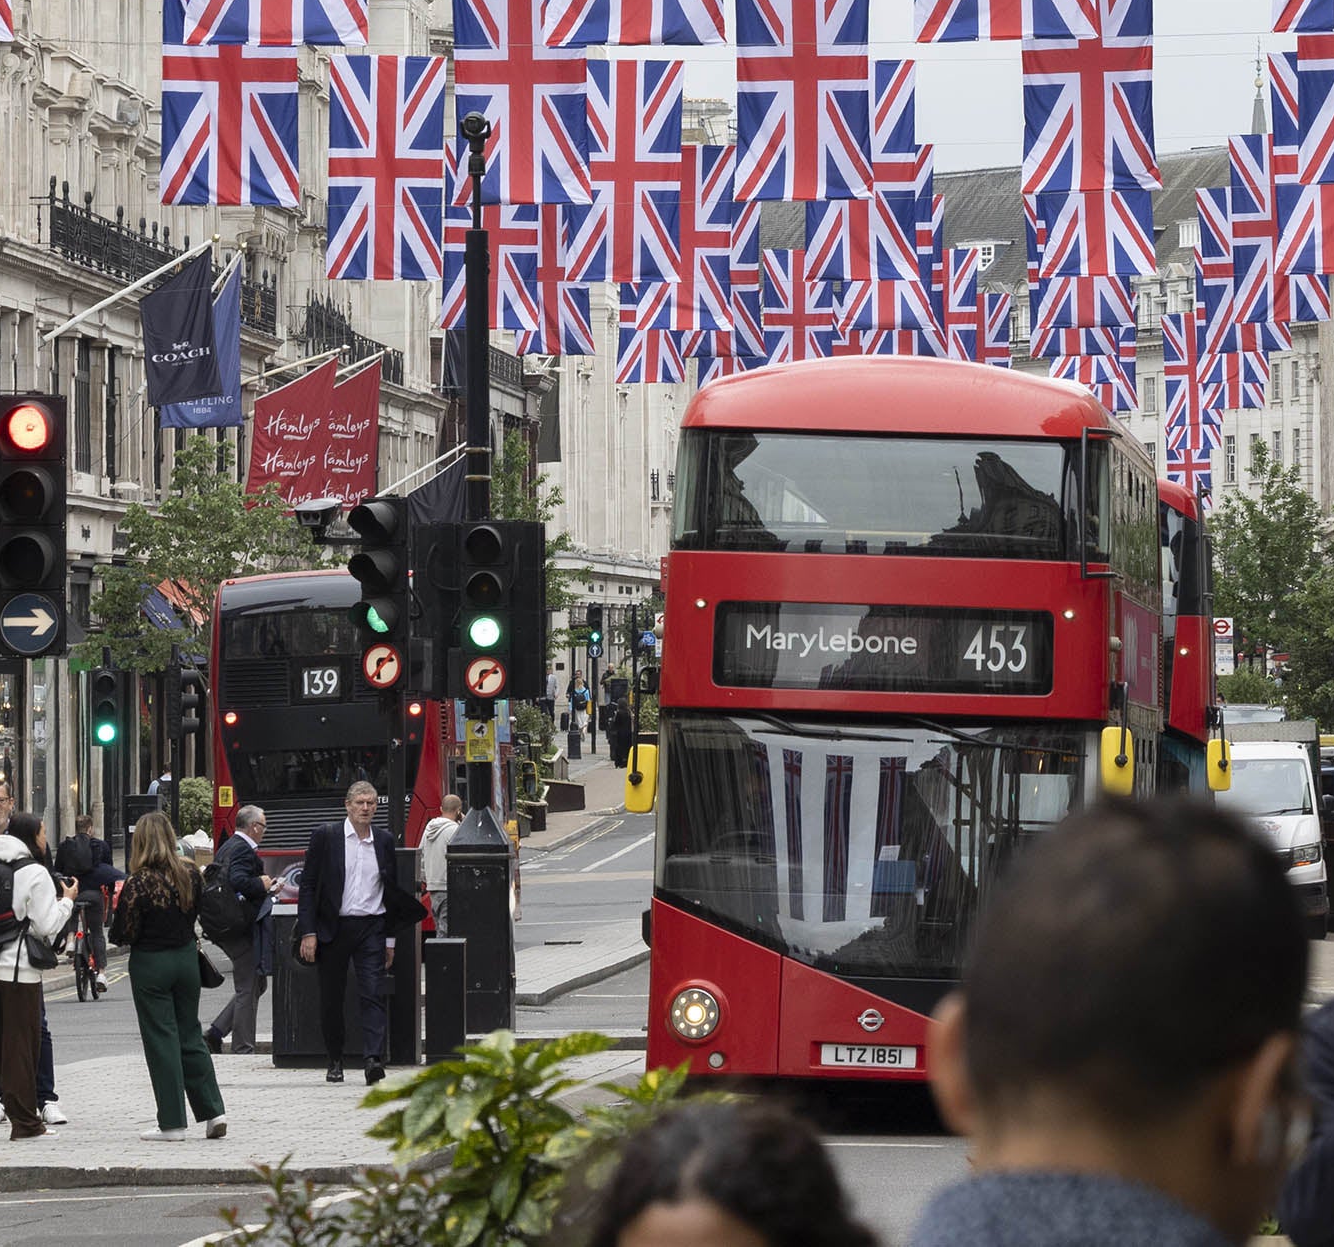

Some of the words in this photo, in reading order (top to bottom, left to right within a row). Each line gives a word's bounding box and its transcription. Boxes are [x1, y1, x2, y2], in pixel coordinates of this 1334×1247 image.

[151, 347, 211, 363] COACH
[263, 409, 321, 440] Hamleys
[328, 410, 370, 440] amleys
[260, 447, 316, 477] Hamleys
[746, 624, 918, 658] Marylebone
[963, 625, 1028, 673] 453
[302, 668, 339, 696] 139
